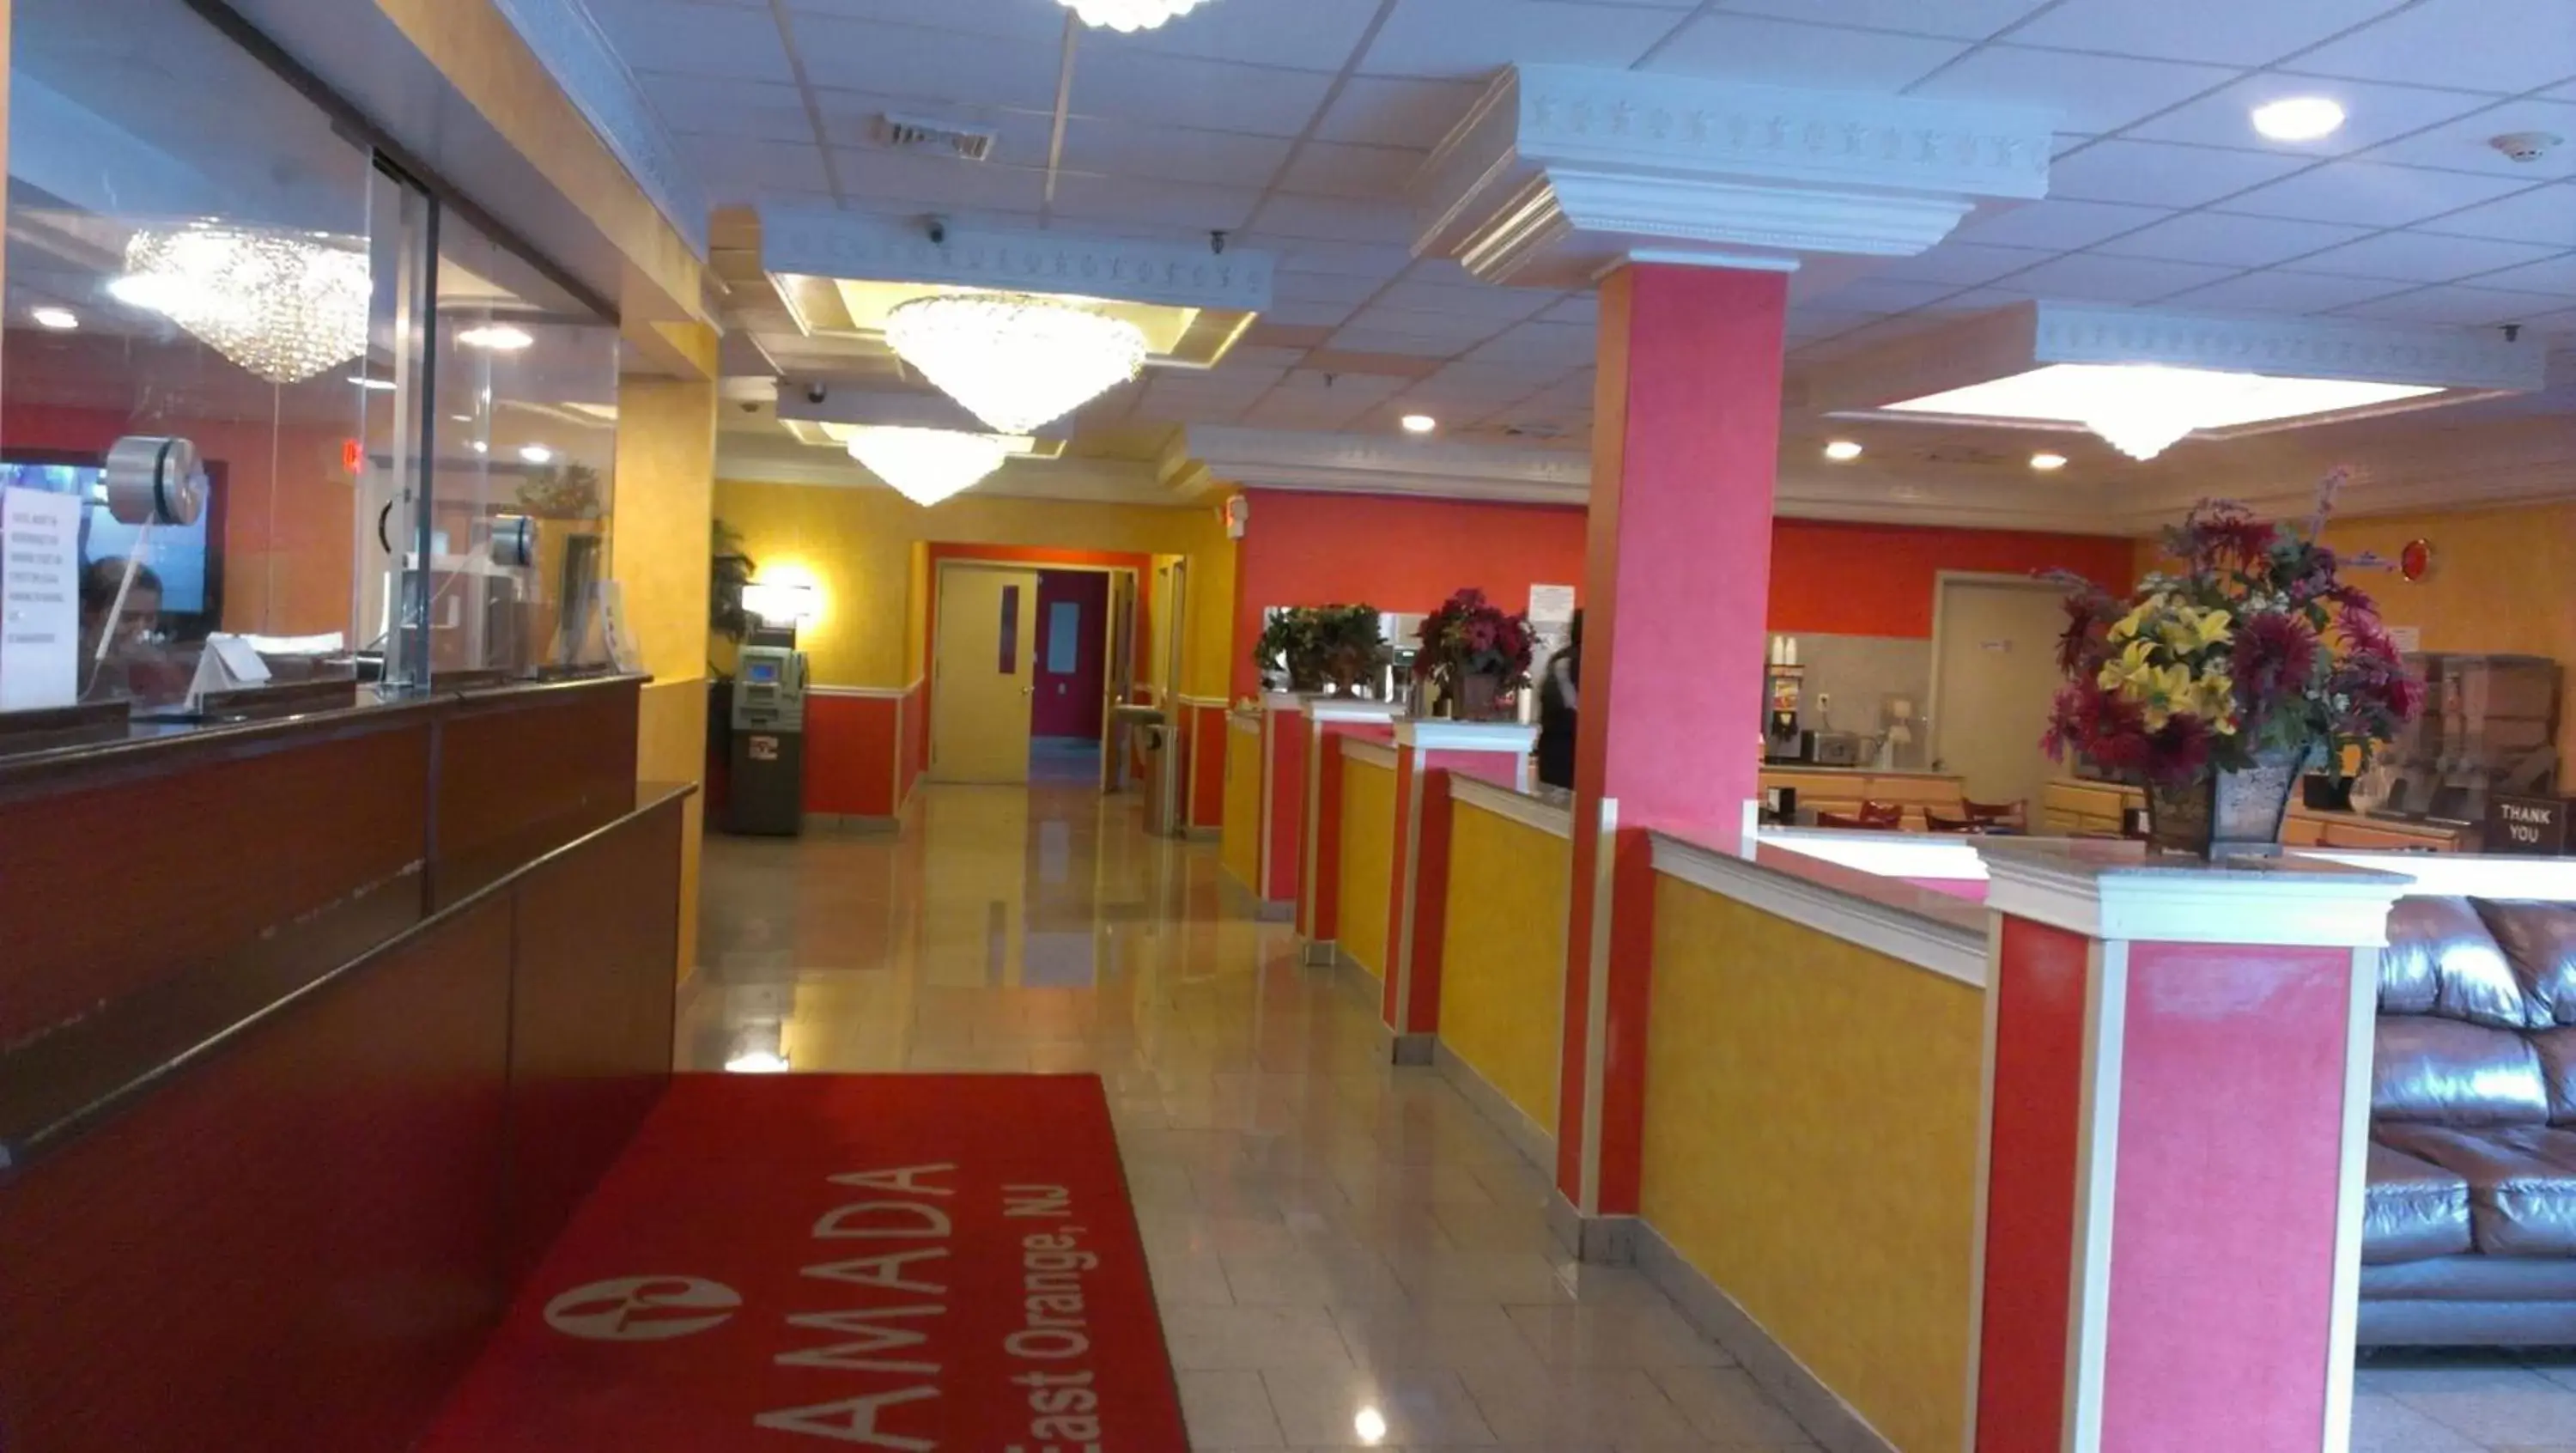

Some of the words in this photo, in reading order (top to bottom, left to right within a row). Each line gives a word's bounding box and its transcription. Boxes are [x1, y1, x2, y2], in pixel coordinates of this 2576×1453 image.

[2500, 804, 2552, 824] THANK
[2509, 824, 2539, 842] YOU
[1000, 1184, 1072, 1216] NJ
[752, 1162, 957, 1453] AMADA
[1003, 1225, 1098, 1359] Orange,
